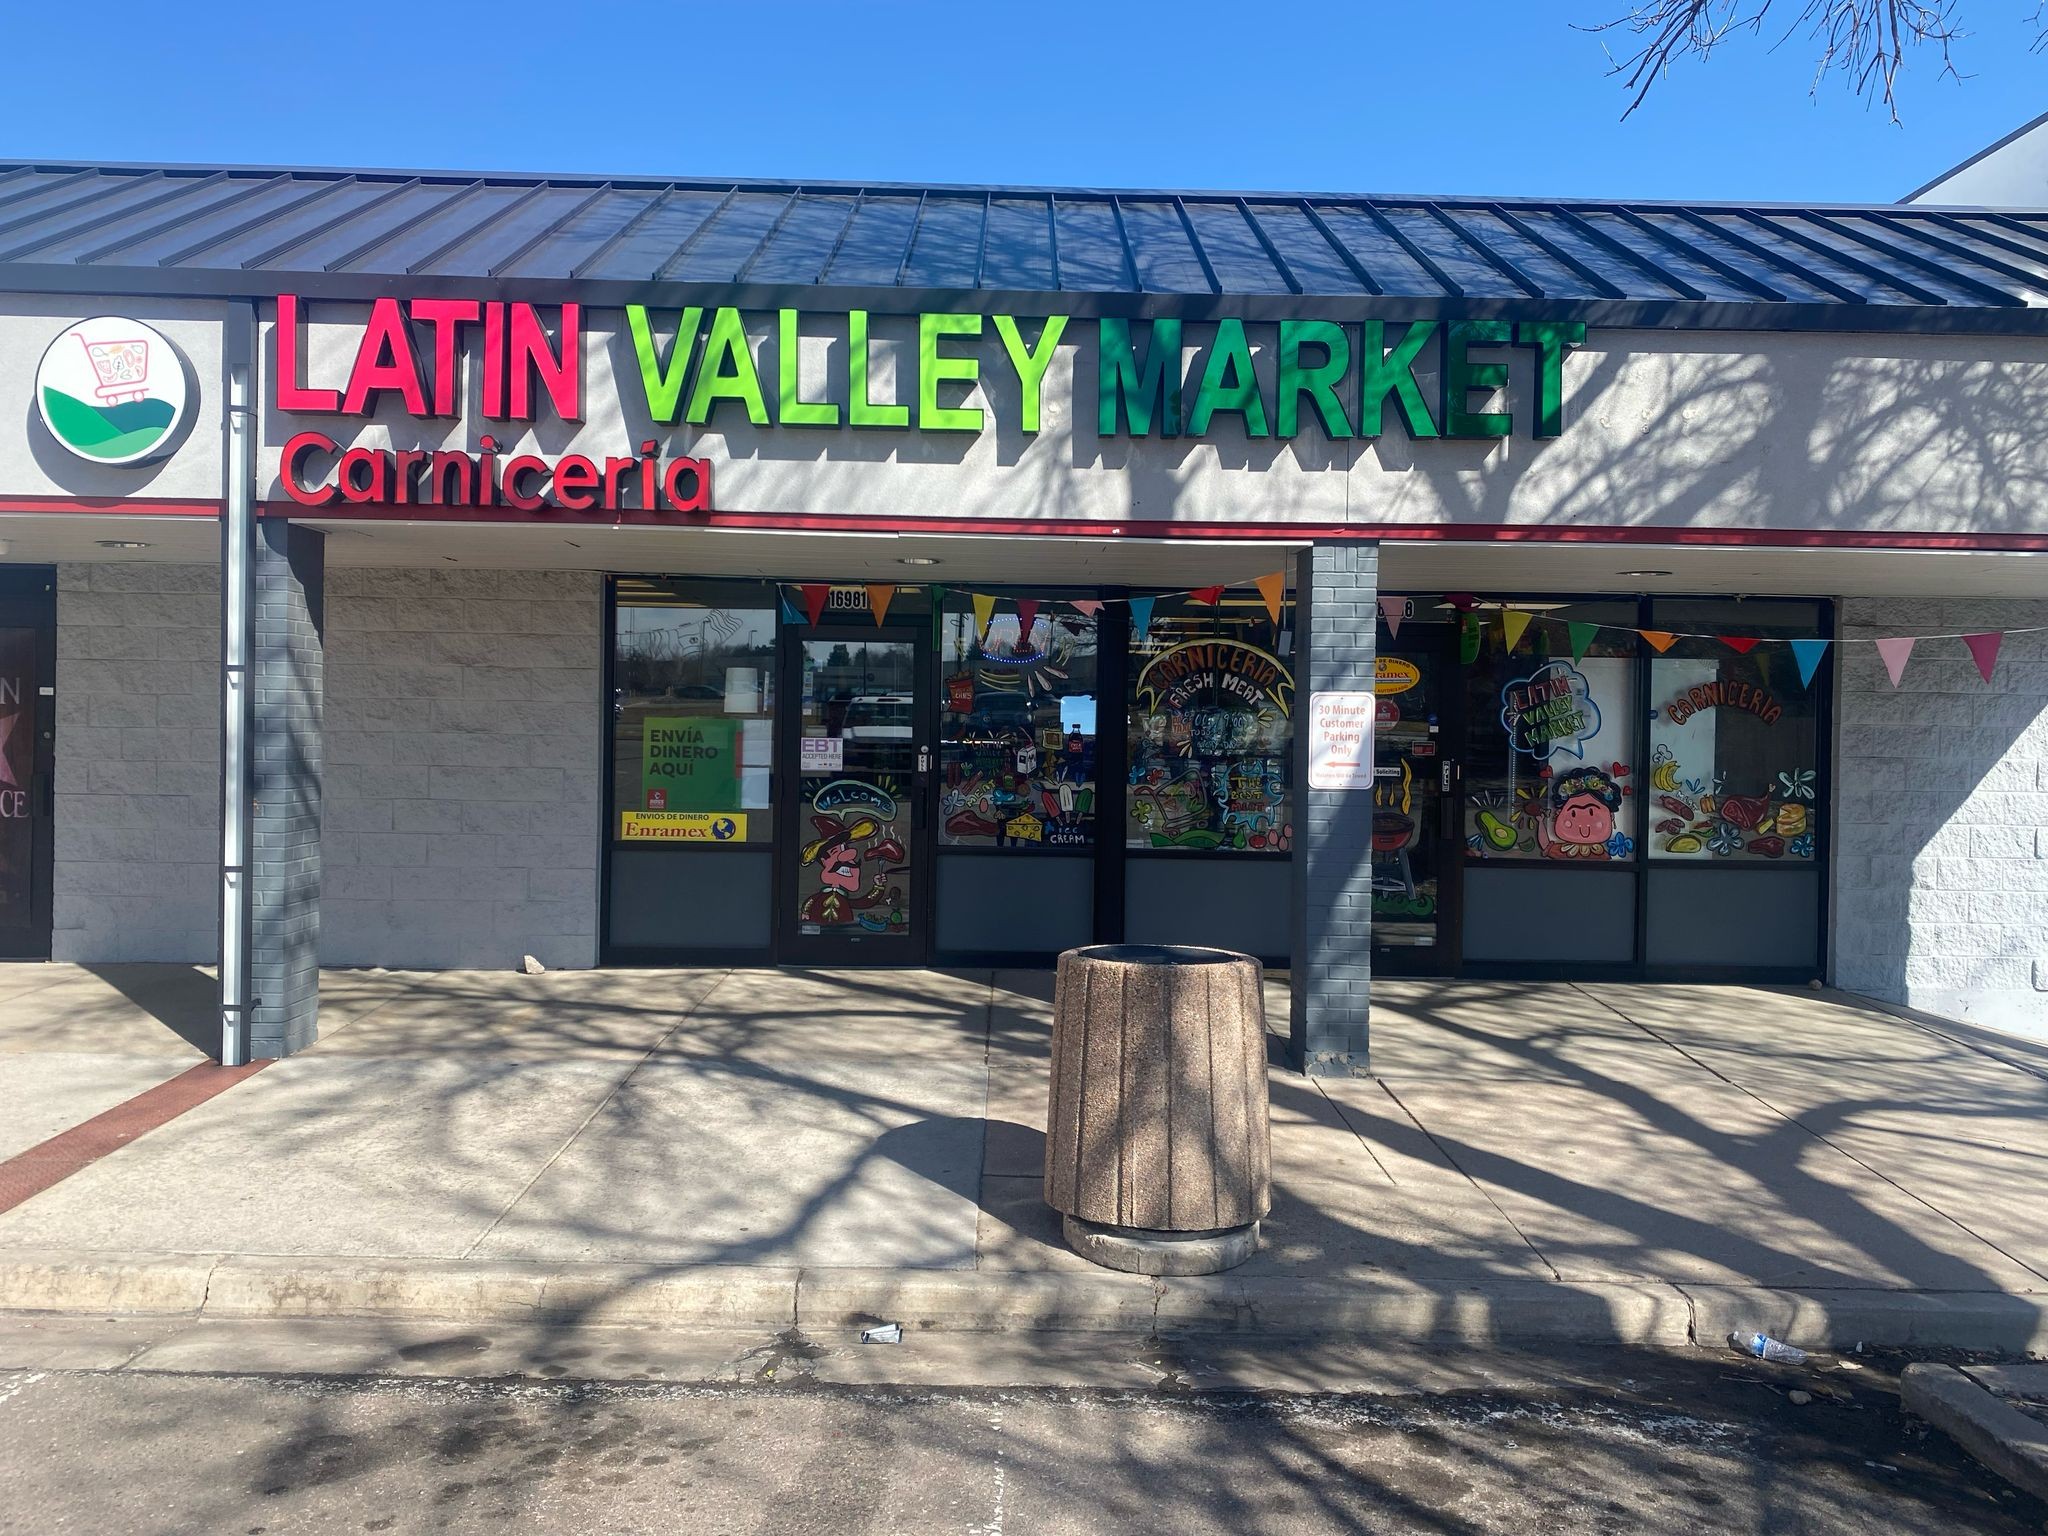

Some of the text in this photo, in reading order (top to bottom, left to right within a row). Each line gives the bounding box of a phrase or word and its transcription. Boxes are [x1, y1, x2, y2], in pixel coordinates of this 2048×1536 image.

[276, 294, 1588, 439] LATIN VALLEY MARKET
[279, 431, 713, 512] Carnicería
[1148, 644, 1279, 689] CARNICERIA
[1169, 672, 1265, 708] FRESH MEAT
[1514, 675, 1572, 710] LATIN
[1319, 705, 1366, 715] 30 Minute
[1522, 695, 1573, 726] VALLEY
[1667, 680, 1784, 726] CARNICERIA
[1319, 719, 1365, 729] Customer
[1524, 711, 1586, 747] MARKET
[650, 726, 704, 743] ENVÍA
[1323, 731, 1360, 743] Parking
[650, 745, 718, 759] DINERO
[801, 739, 841, 753] EBT
[1330, 745, 1353, 757] Only
[649, 759, 694, 778] AQUÍ
[1375, 768, 1400, 777] Soliciting
[624, 822, 708, 838] Enramex
[1050, 834, 1085, 844] CREAM
